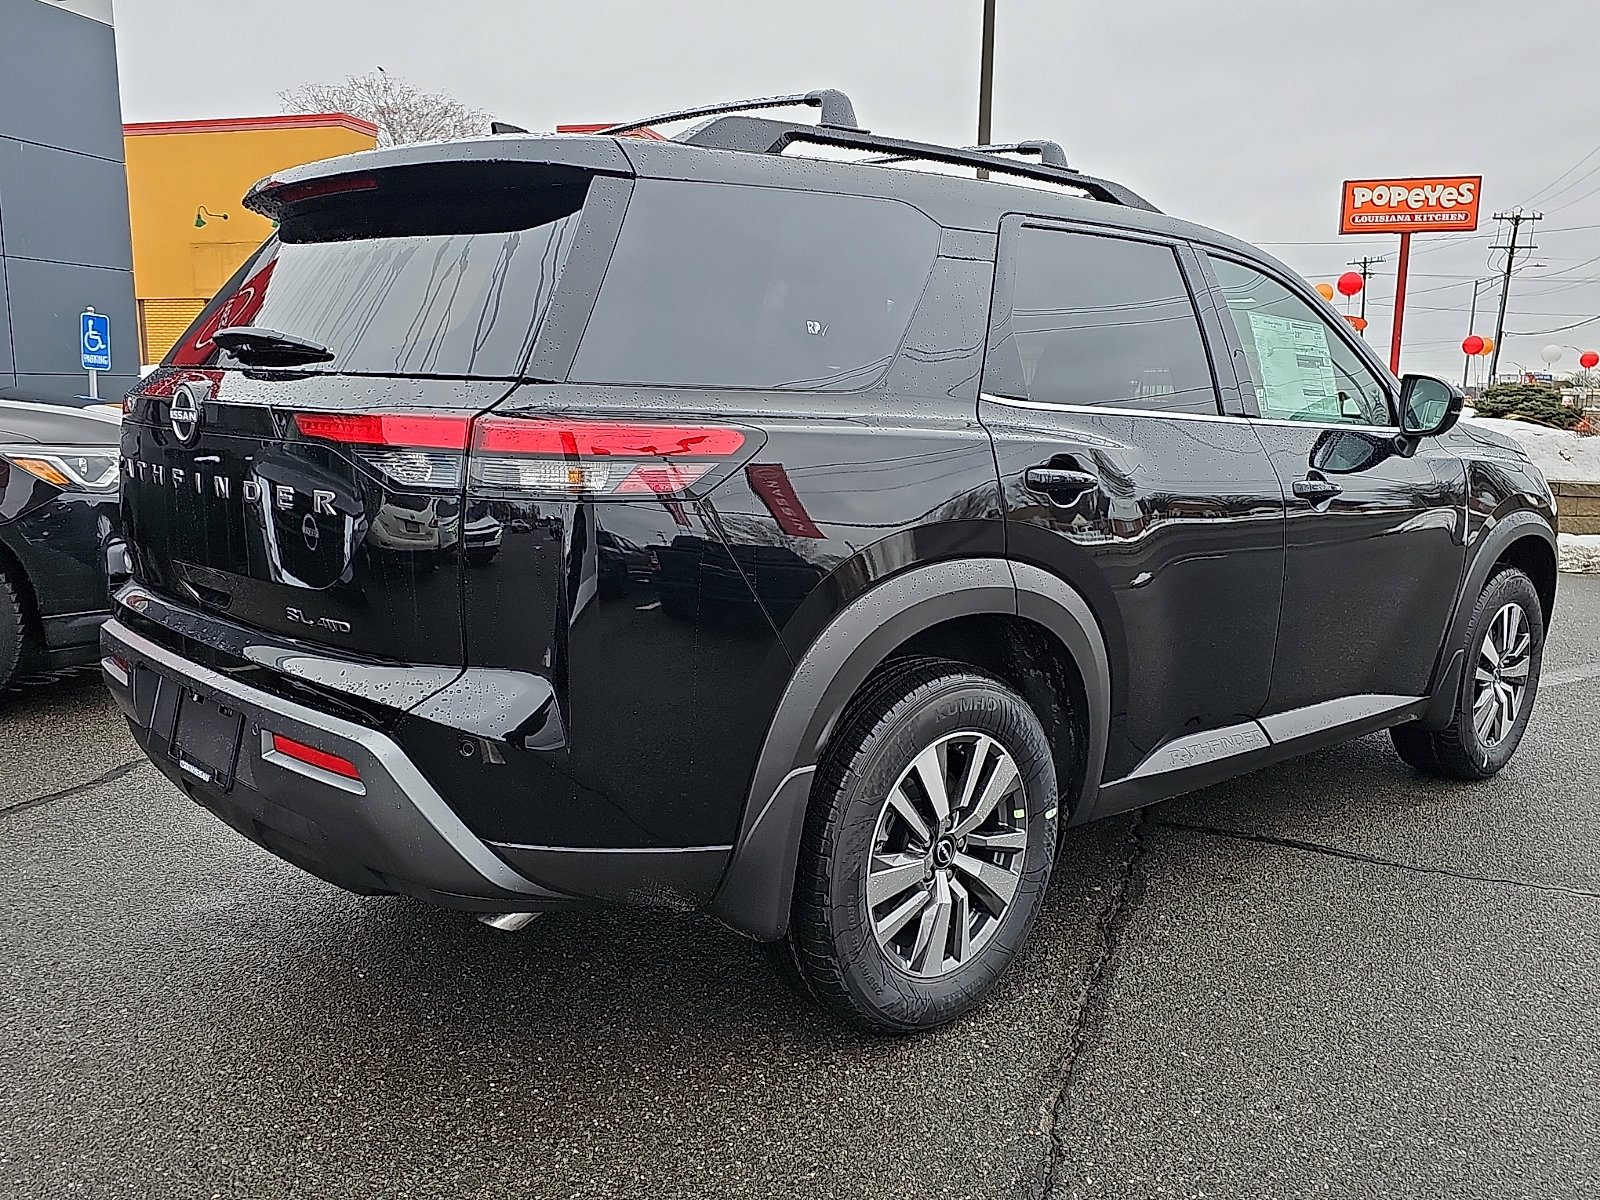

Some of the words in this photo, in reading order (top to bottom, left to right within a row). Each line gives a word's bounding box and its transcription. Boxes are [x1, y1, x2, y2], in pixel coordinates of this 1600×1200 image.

[1354, 214, 1411, 223] LOUISIANA
[1413, 213, 1466, 222] KITCHEN
[83, 354, 108, 365] PARKING
[286, 607, 314, 626] SL
[935, 696, 998, 723] KUMHO
[1167, 729, 1264, 765] PATHFINDER
